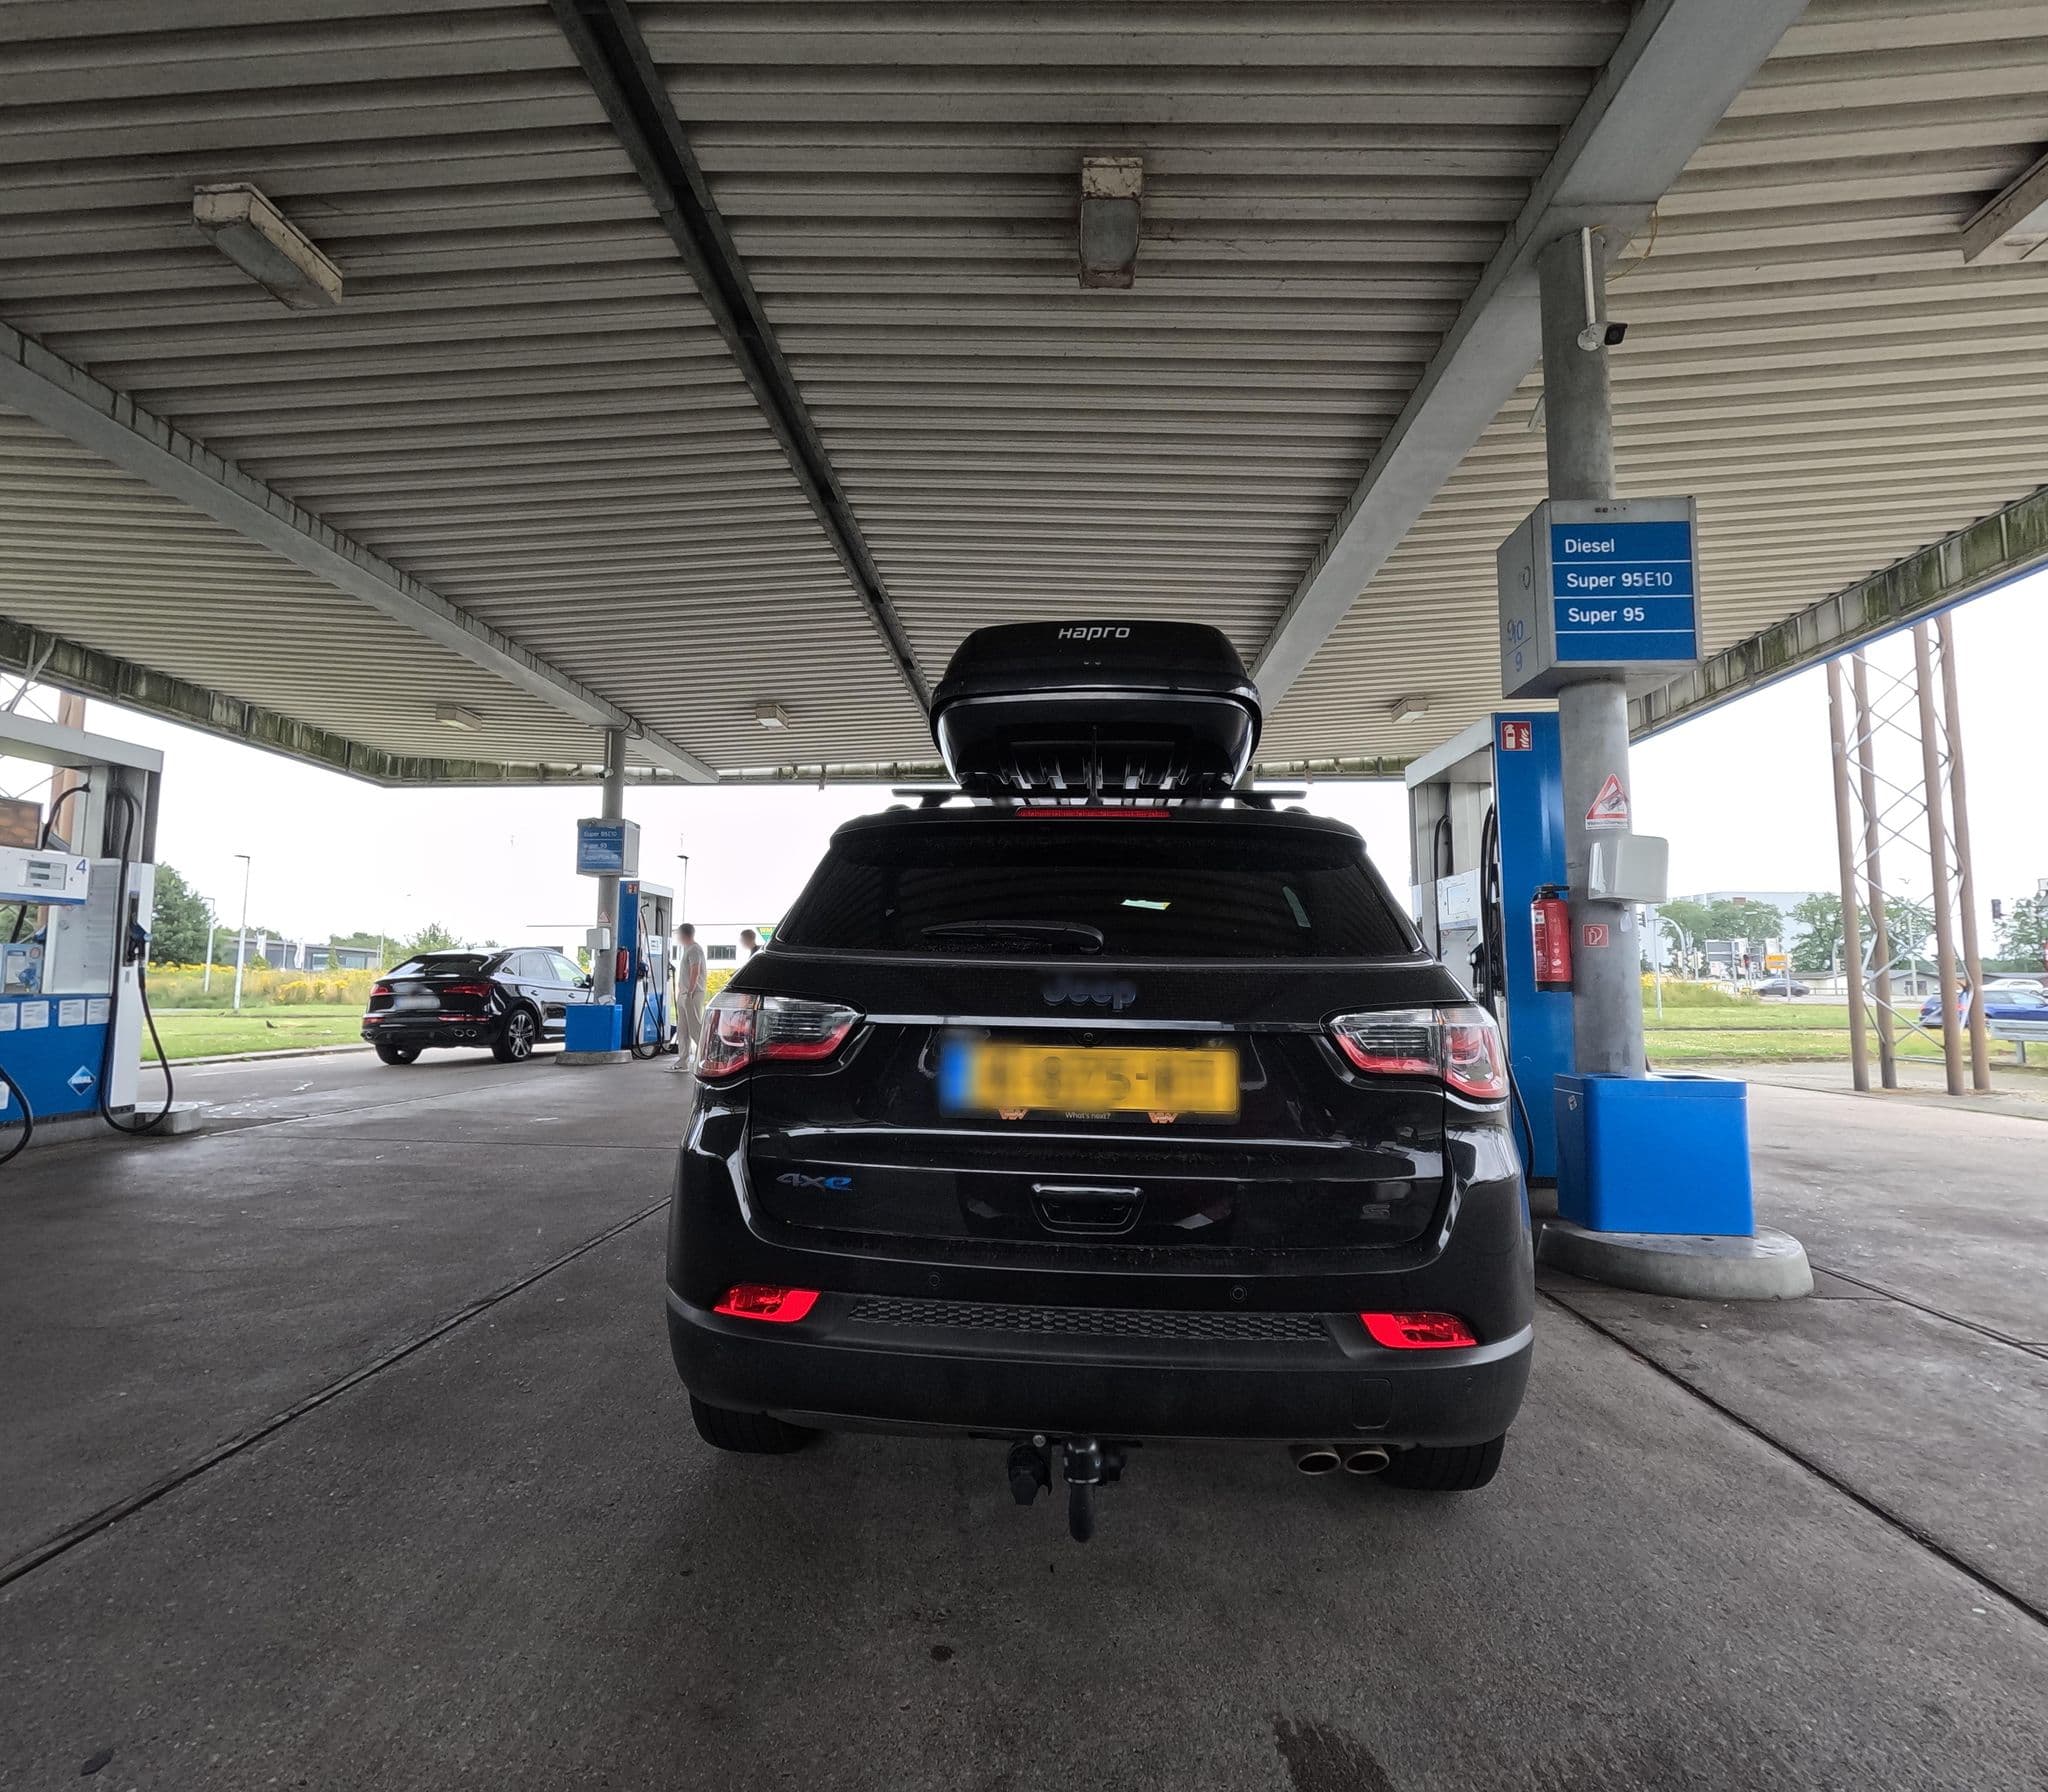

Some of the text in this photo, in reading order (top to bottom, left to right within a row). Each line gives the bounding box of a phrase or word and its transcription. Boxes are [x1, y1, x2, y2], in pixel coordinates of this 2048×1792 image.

[1564, 538, 1615, 553] Diesel
[1566, 573, 1616, 590] Super
[1568, 607, 1645, 625] Super 95
[1057, 627, 1131, 641] Hapro
[75, 858, 88, 875] 4
